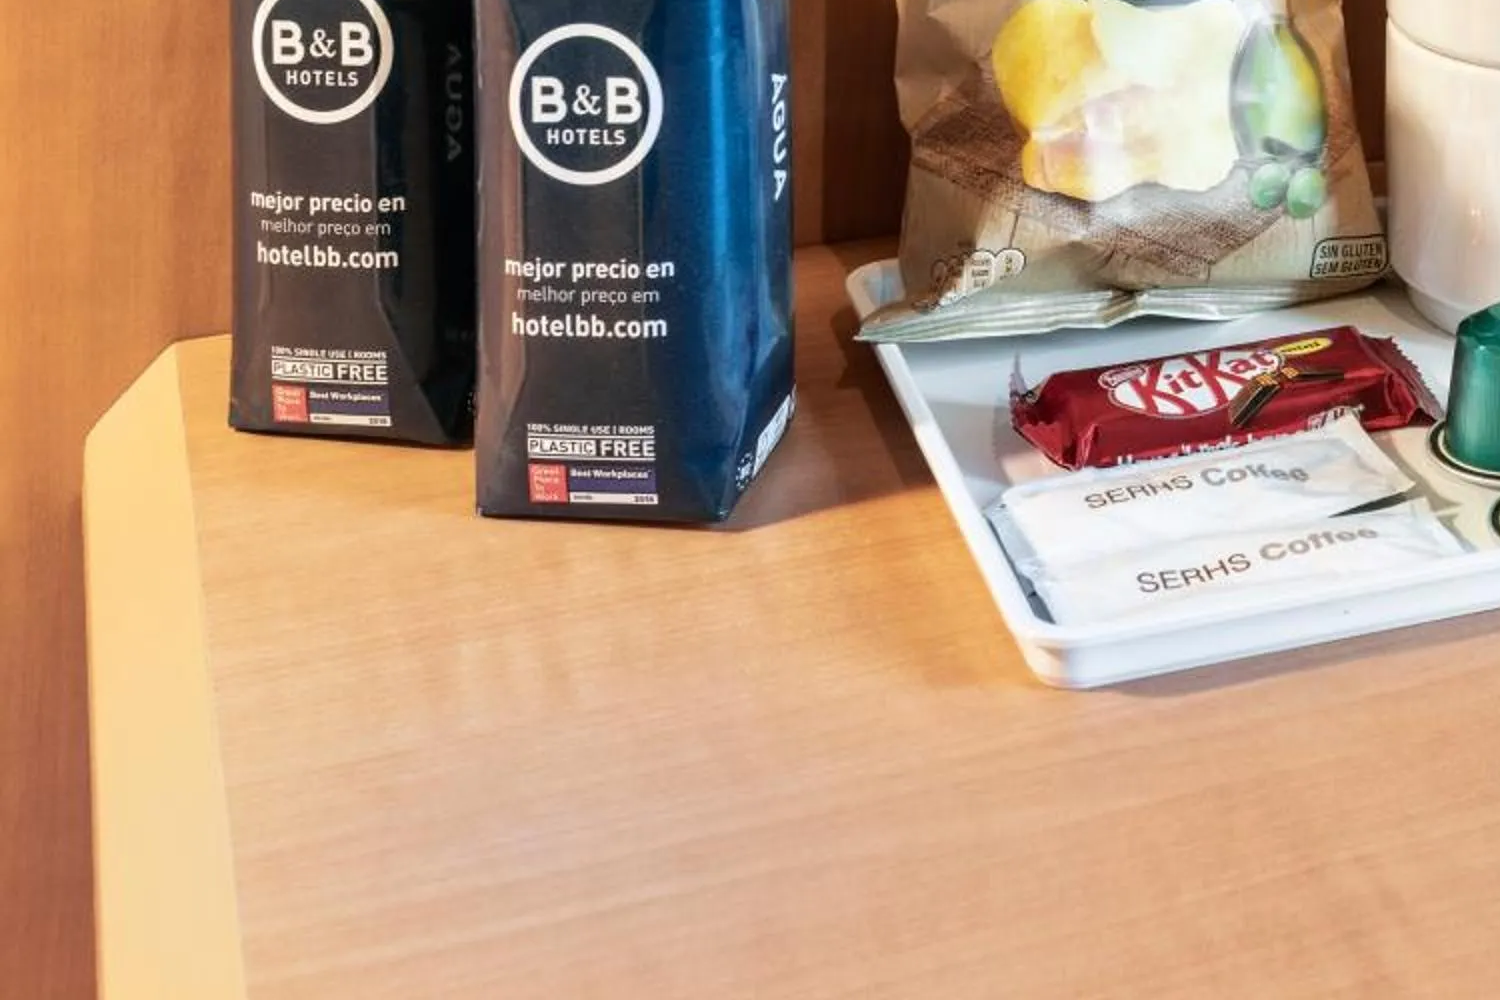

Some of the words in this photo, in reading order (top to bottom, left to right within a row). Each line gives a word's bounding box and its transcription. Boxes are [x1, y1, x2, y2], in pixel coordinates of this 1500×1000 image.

[271, 20, 373, 67] B&B
[286, 70, 359, 87] HOTELS
[531, 75, 643, 124] B&B
[547, 128, 626, 145] HOTELS
[770, 73, 788, 202] AGUA
[250, 190, 304, 215] mejor
[309, 193, 372, 216] precio
[377, 196, 405, 213] en
[261, 217, 313, 234] melhor
[317, 221, 361, 238] preço
[365, 223, 391, 236] em
[256, 240, 399, 268] hotelbb.com
[1320, 244, 1338, 258] SIN
[504, 257, 566, 282] mejor
[571, 258, 640, 282] precio
[646, 260, 675, 279] en
[1314, 261, 1339, 274] SEM
[517, 286, 576, 303] melhor
[581, 288, 627, 306] preço
[632, 291, 660, 303] em
[511, 312, 669, 338] hotelbb.com
[273, 361, 331, 379] PLASTIC
[337, 364, 388, 381] FREE
[1129, 350, 1276, 415] KitKat
[330, 391, 381, 403] Workplaces
[527, 423, 552, 433] 100%
[590, 425, 611, 434] USE
[618, 425, 655, 435] ROOMS
[530, 440, 593, 454] PLASTIC
[600, 440, 656, 457] FREE
[592, 468, 649, 480] Workplaces
[1084, 474, 1194, 511] SERHS
[1136, 553, 1252, 596] SERHS
[1258, 526, 1379, 562] Coffee
